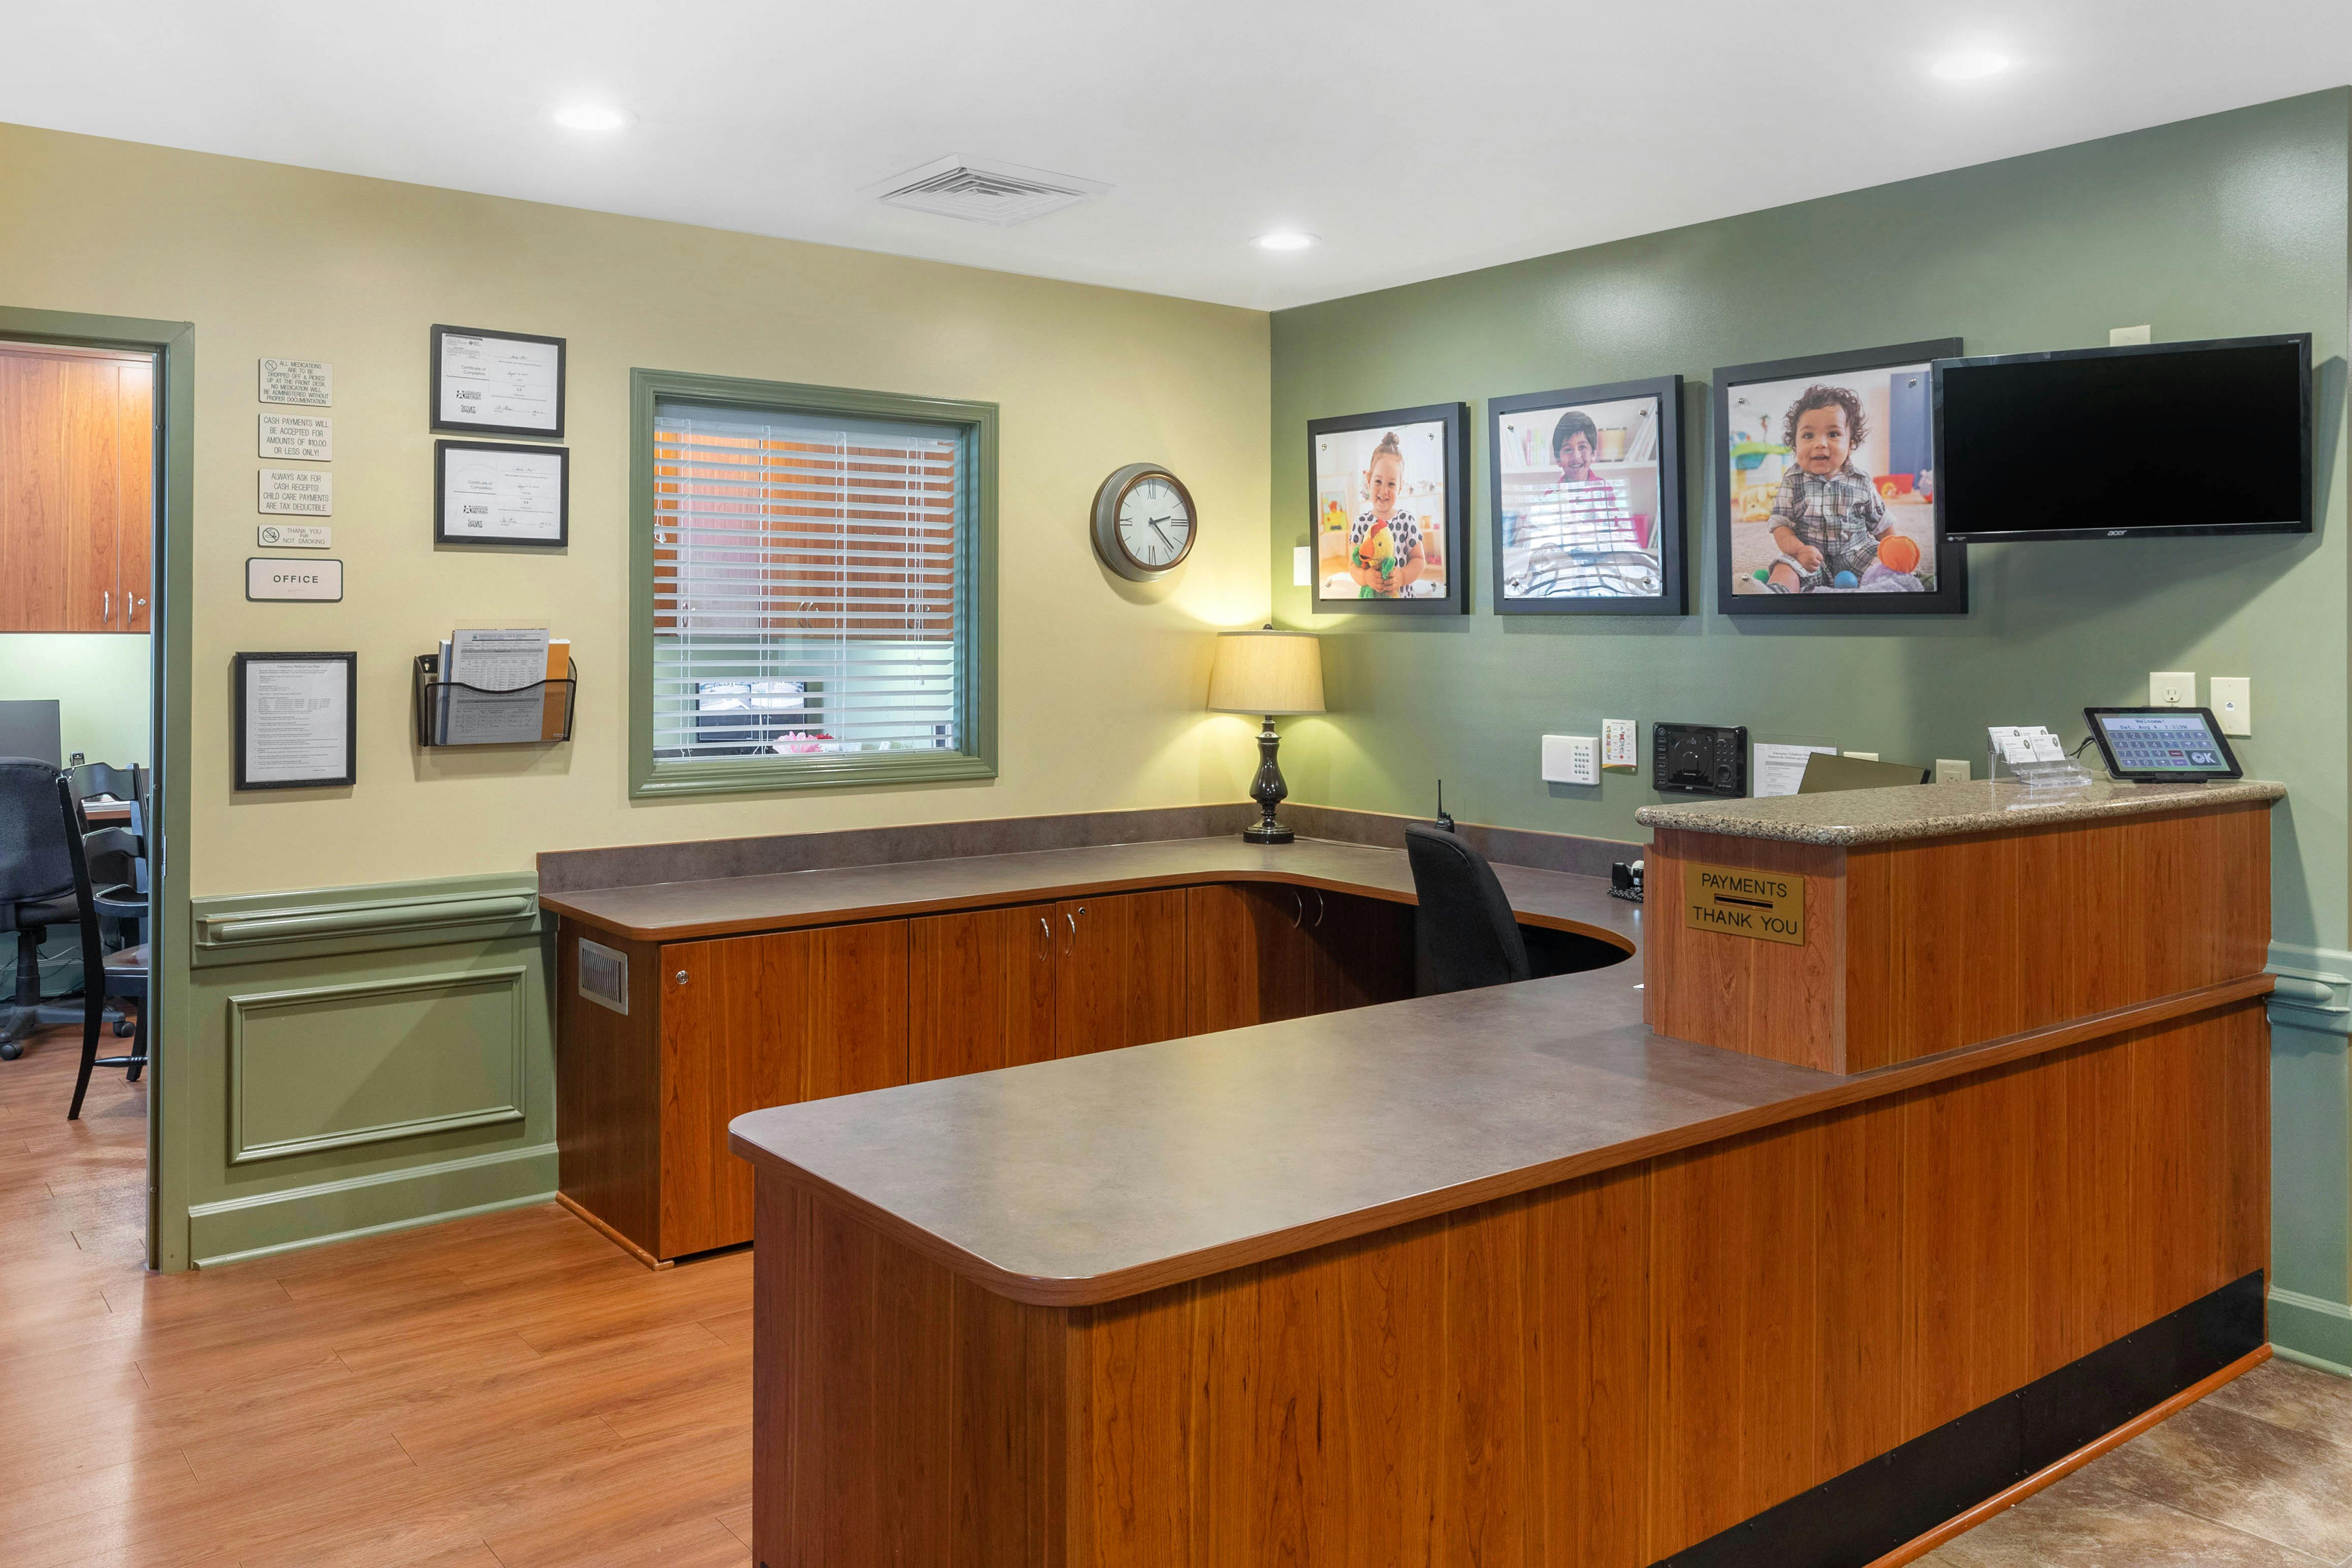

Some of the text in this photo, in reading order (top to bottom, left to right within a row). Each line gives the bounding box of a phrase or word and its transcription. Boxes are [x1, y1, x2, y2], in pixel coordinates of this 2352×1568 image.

[282, 418, 312, 427] PAYMENTS
[280, 428, 309, 436] ACCEPTED
[266, 437, 295, 445] AMOUNTS
[271, 473, 294, 481] ALWAYS
[293, 503, 327, 511] DEDUCTIBLE
[273, 575, 318, 583] OFFICE
[2191, 752, 2216, 764] OK
[1702, 873, 1787, 898] PAYMENTS
[1693, 906, 1797, 935] THANK YOU
